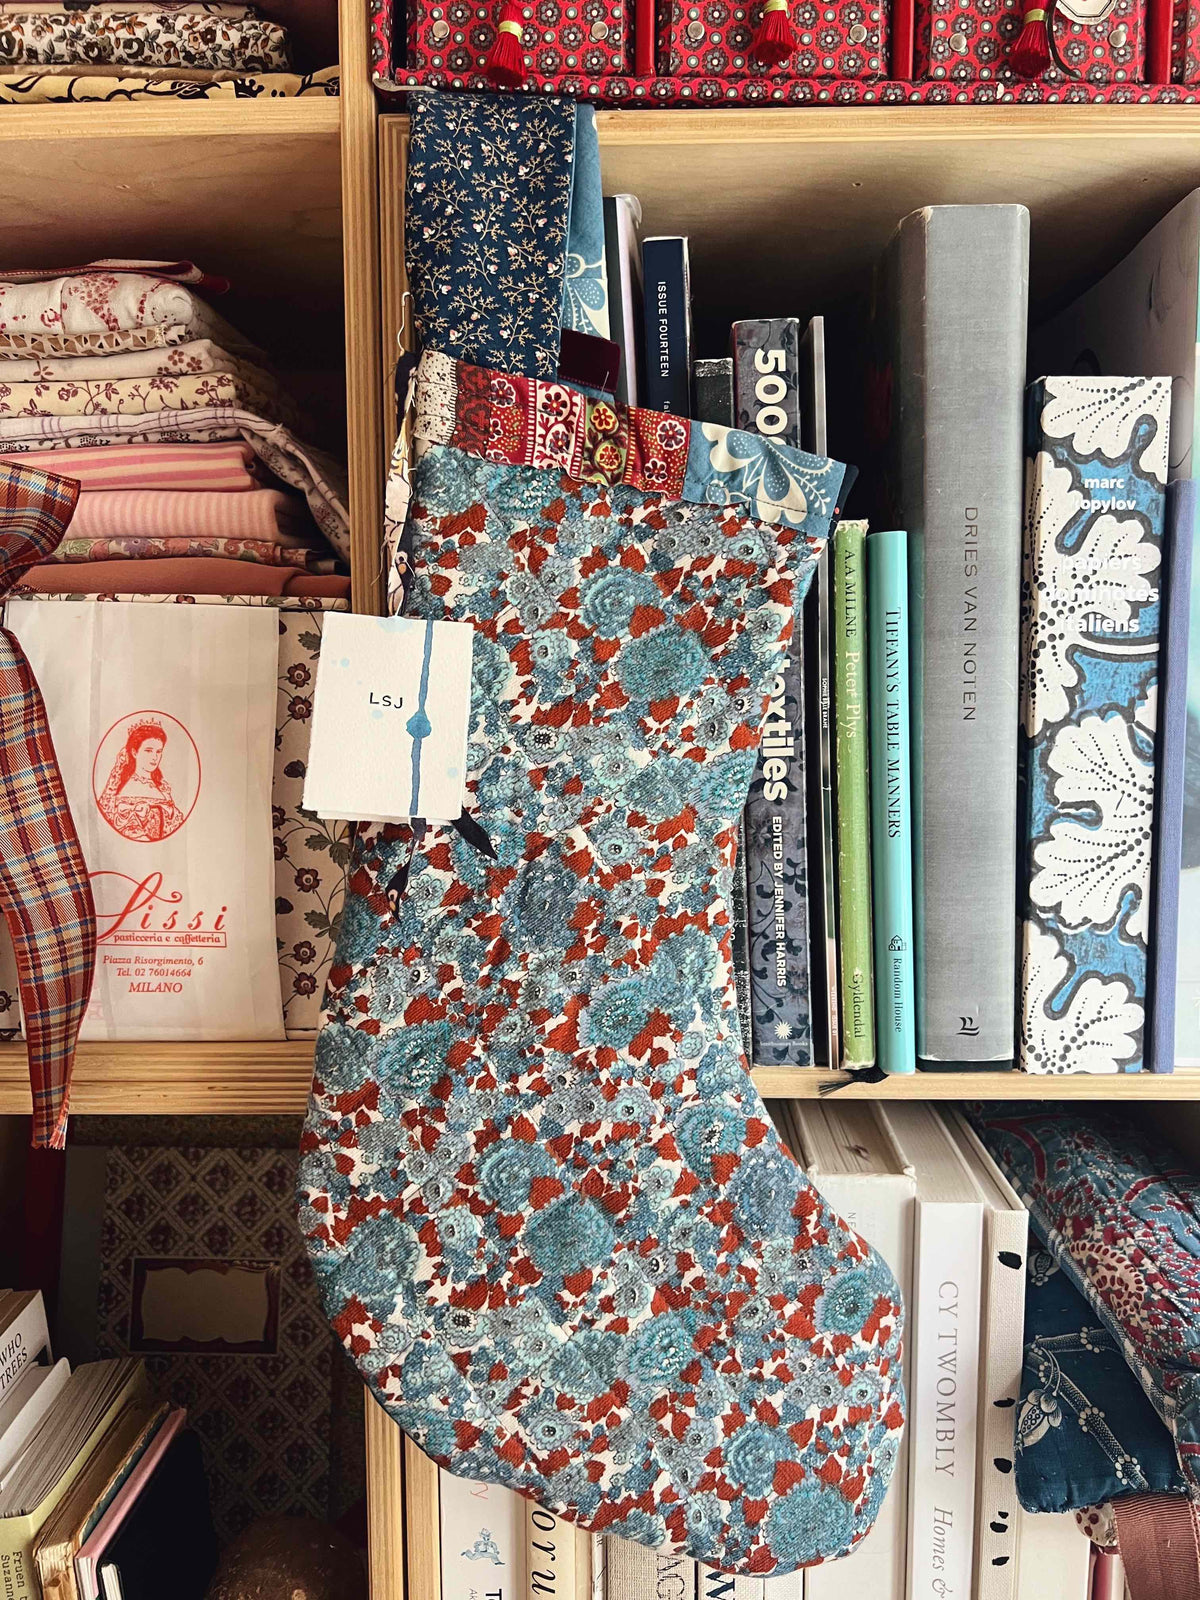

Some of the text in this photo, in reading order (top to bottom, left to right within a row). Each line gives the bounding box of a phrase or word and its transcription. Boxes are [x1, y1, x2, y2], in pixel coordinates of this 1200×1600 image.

[658, 281, 670, 377] ISSUE FOURTEEN
[754, 348, 788, 445] 500
[1073, 496, 1136, 513] opylov
[1084, 478, 1125, 488] marc
[845, 582, 856, 638] MILNE
[962, 507, 978, 721] DRIES VAN NOTEN
[370, 692, 403, 709] LSJ
[840, 651, 862, 738] Peter Plys
[886, 606, 902, 838] TIFFANY'S TABLE MANNERS
[772, 816, 787, 987] EDITED BY JENNIFER HARRIS
[102, 956, 204, 966] Piazza Risorgimento, 6
[114, 932, 162, 943] pasticceria
[174, 934, 220, 944] caffetteria
[128, 982, 183, 993] MILANO
[134, 968, 146, 976] 02
[148, 968, 192, 978] 76014664
[893, 958, 904, 1032] Random House
[848, 973, 866, 1038] Gyldendal
[0, 1347, 28, 1390] TREES
[934, 1280, 959, 1477] CY TWOMBLY
[932, 1506, 953, 1570] Homes
[12, 1551, 24, 1588] Fruen
